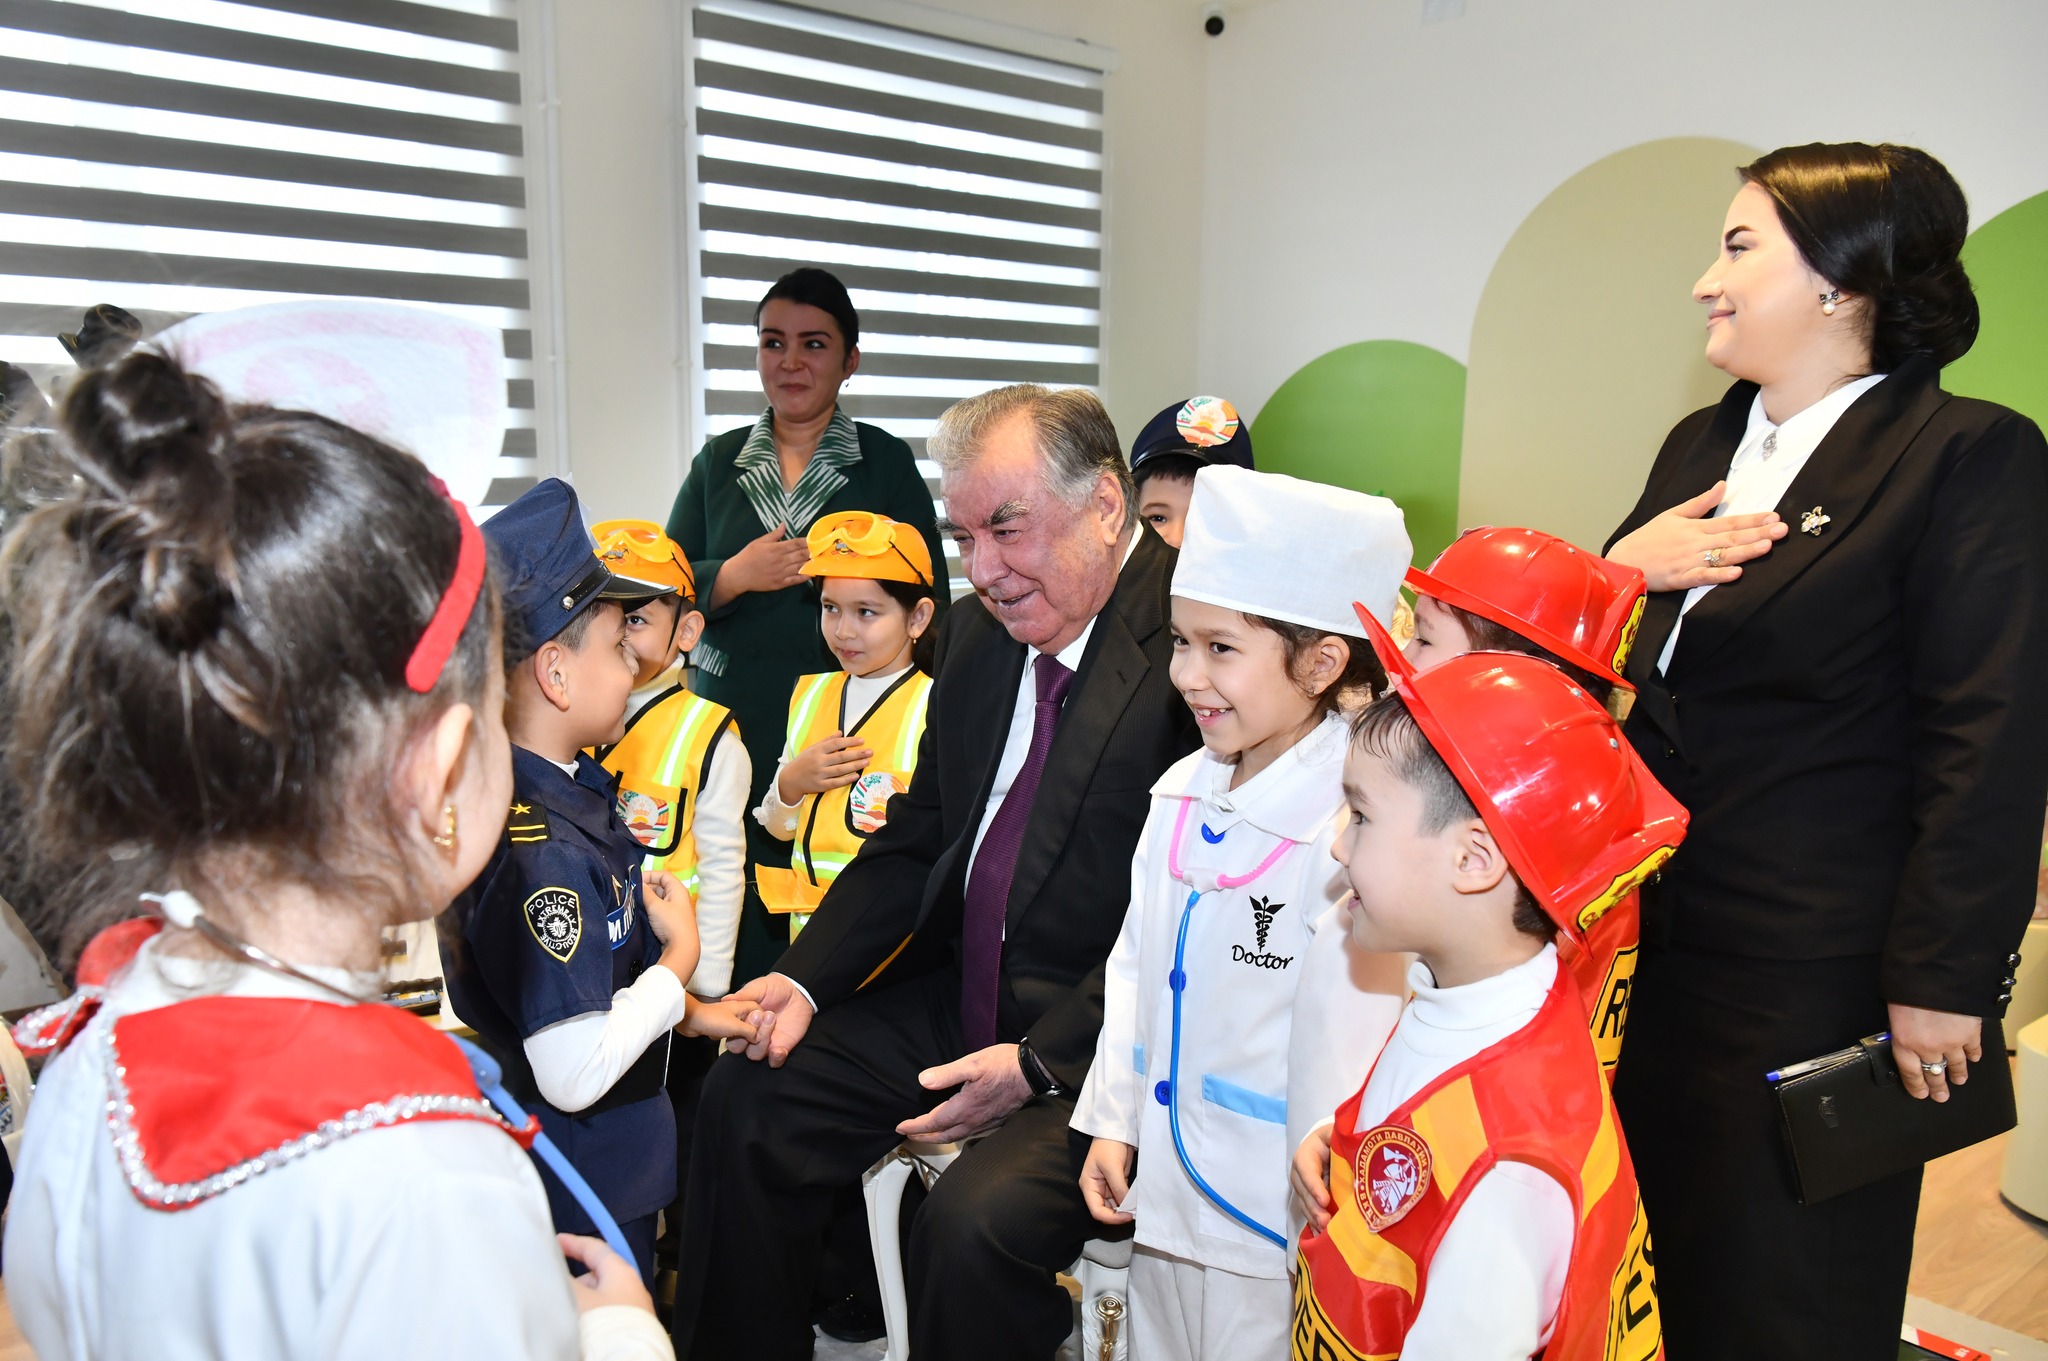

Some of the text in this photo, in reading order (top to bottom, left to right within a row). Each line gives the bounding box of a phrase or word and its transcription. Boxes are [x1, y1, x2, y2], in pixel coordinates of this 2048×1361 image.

[528, 893, 576, 915] POLICE
[540, 928, 578, 950] SEDUCTIVE
[1231, 944, 1294, 970] Doctor
[1359, 1133, 1383, 1183] ХАДАМОТИ
